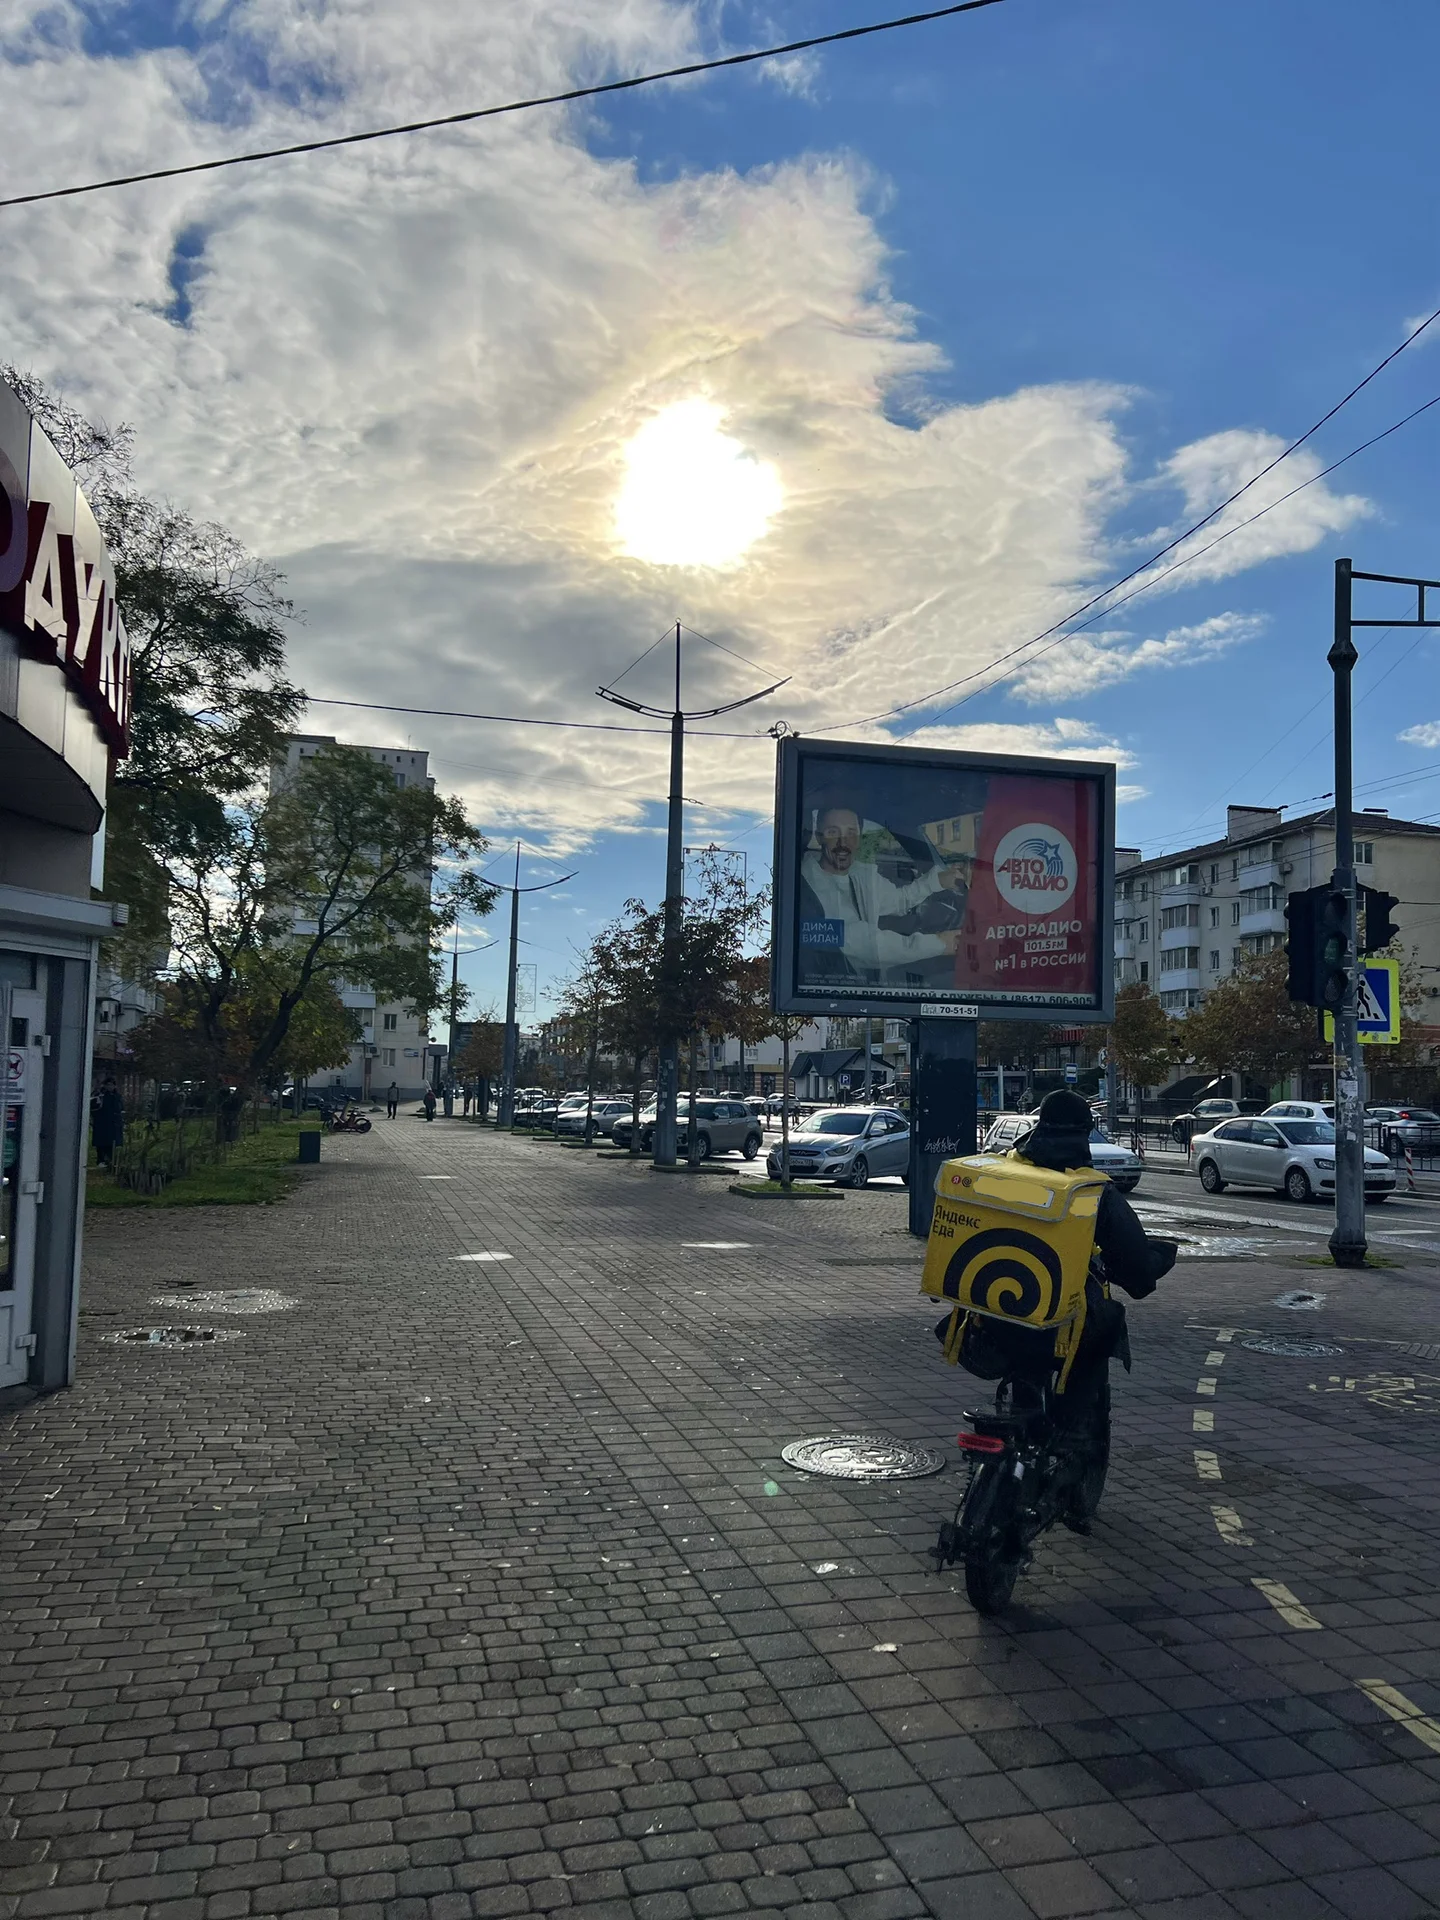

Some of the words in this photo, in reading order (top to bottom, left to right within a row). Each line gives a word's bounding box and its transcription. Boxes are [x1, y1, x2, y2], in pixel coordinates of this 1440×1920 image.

[997, 857, 1045, 874] АВТО
[1010, 873, 1069, 892] РАДИО
[802, 922, 834, 931] ДИМА
[985, 920, 1082, 941] АВТОРАДИО
[802, 934, 839, 943] БИЛАН
[1031, 952, 1087, 968] РОССИИ
[940, 1006, 977, 1016] 70-51-51
[934, 1205, 981, 1229] Яндекс
[932, 1219, 955, 1238] Еда
